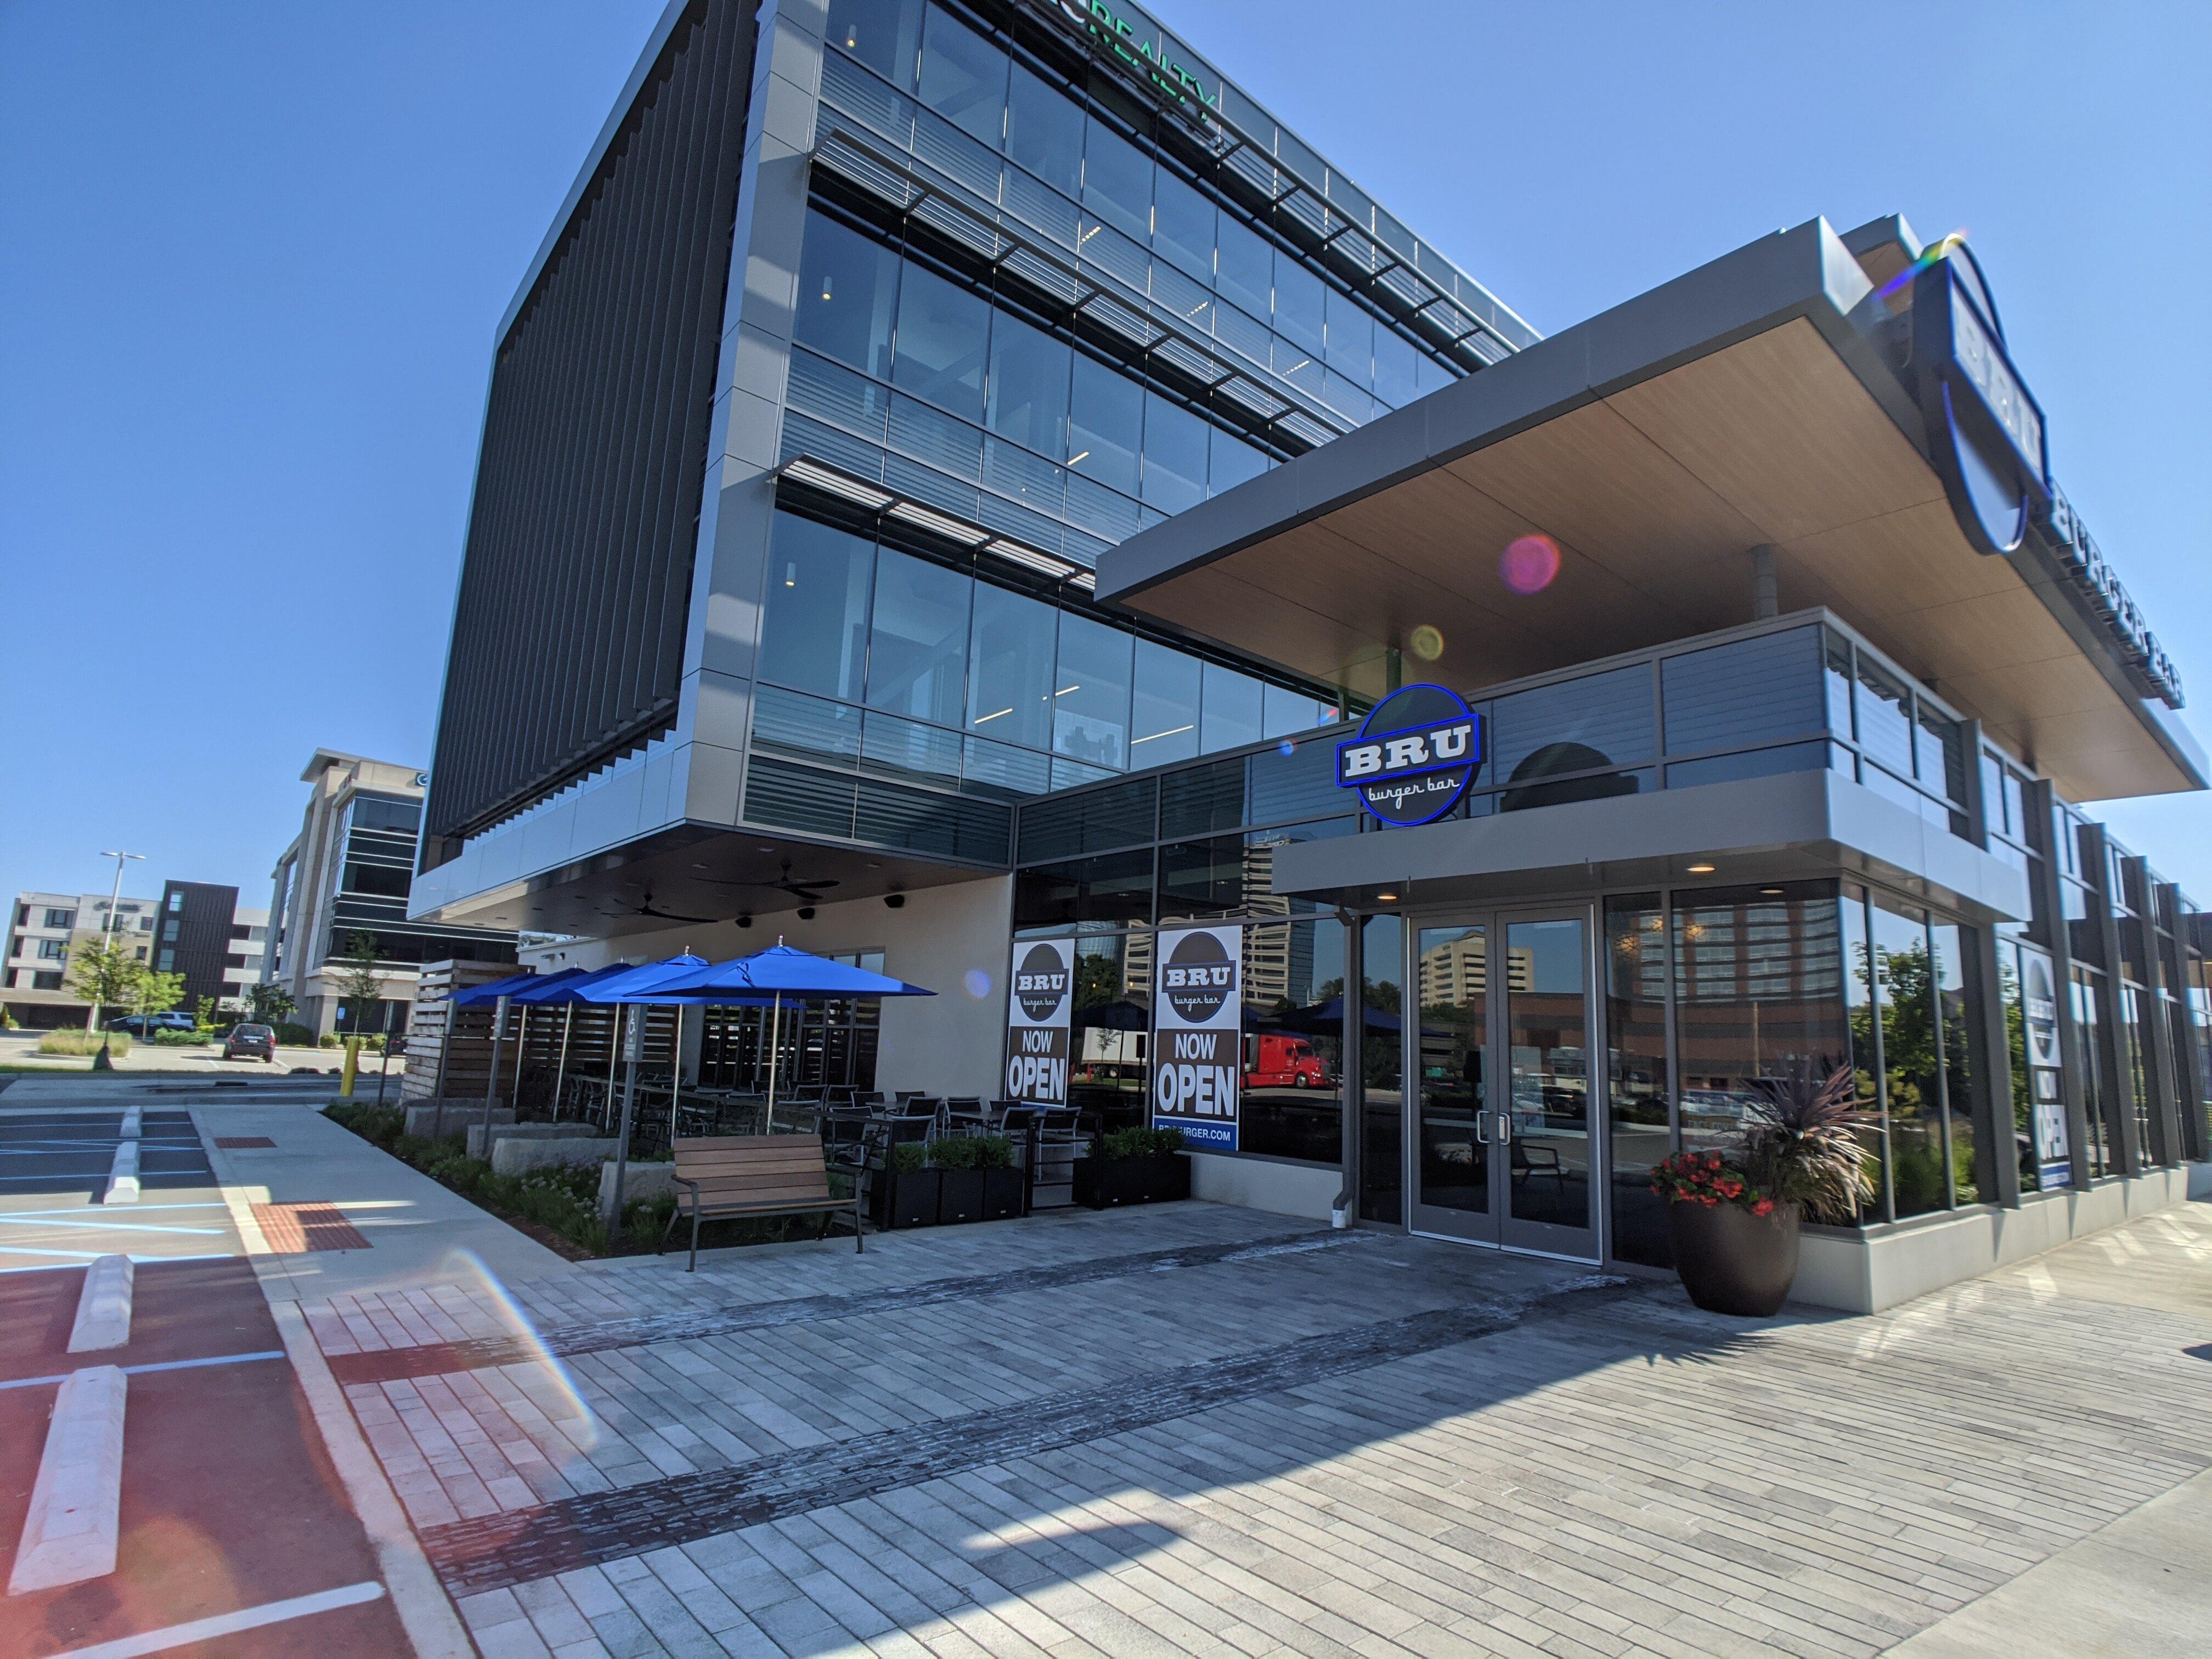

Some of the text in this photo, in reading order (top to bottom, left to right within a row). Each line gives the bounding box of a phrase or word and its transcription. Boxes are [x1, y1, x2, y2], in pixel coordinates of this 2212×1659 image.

[1345, 725, 1471, 777] BRU
[1368, 777, 1460, 809] burger bar
[1018, 974, 1065, 990] BRU
[1167, 967, 1231, 986] BRU
[1024, 997, 1045, 1012] burger
[1175, 994, 1221, 1012] burger bar
[1023, 1030, 1053, 1053] NOW
[1175, 1034, 1217, 1059] NOW
[1009, 1055, 1065, 1100] OPEN
[1158, 1063, 1235, 1116] OPEN
